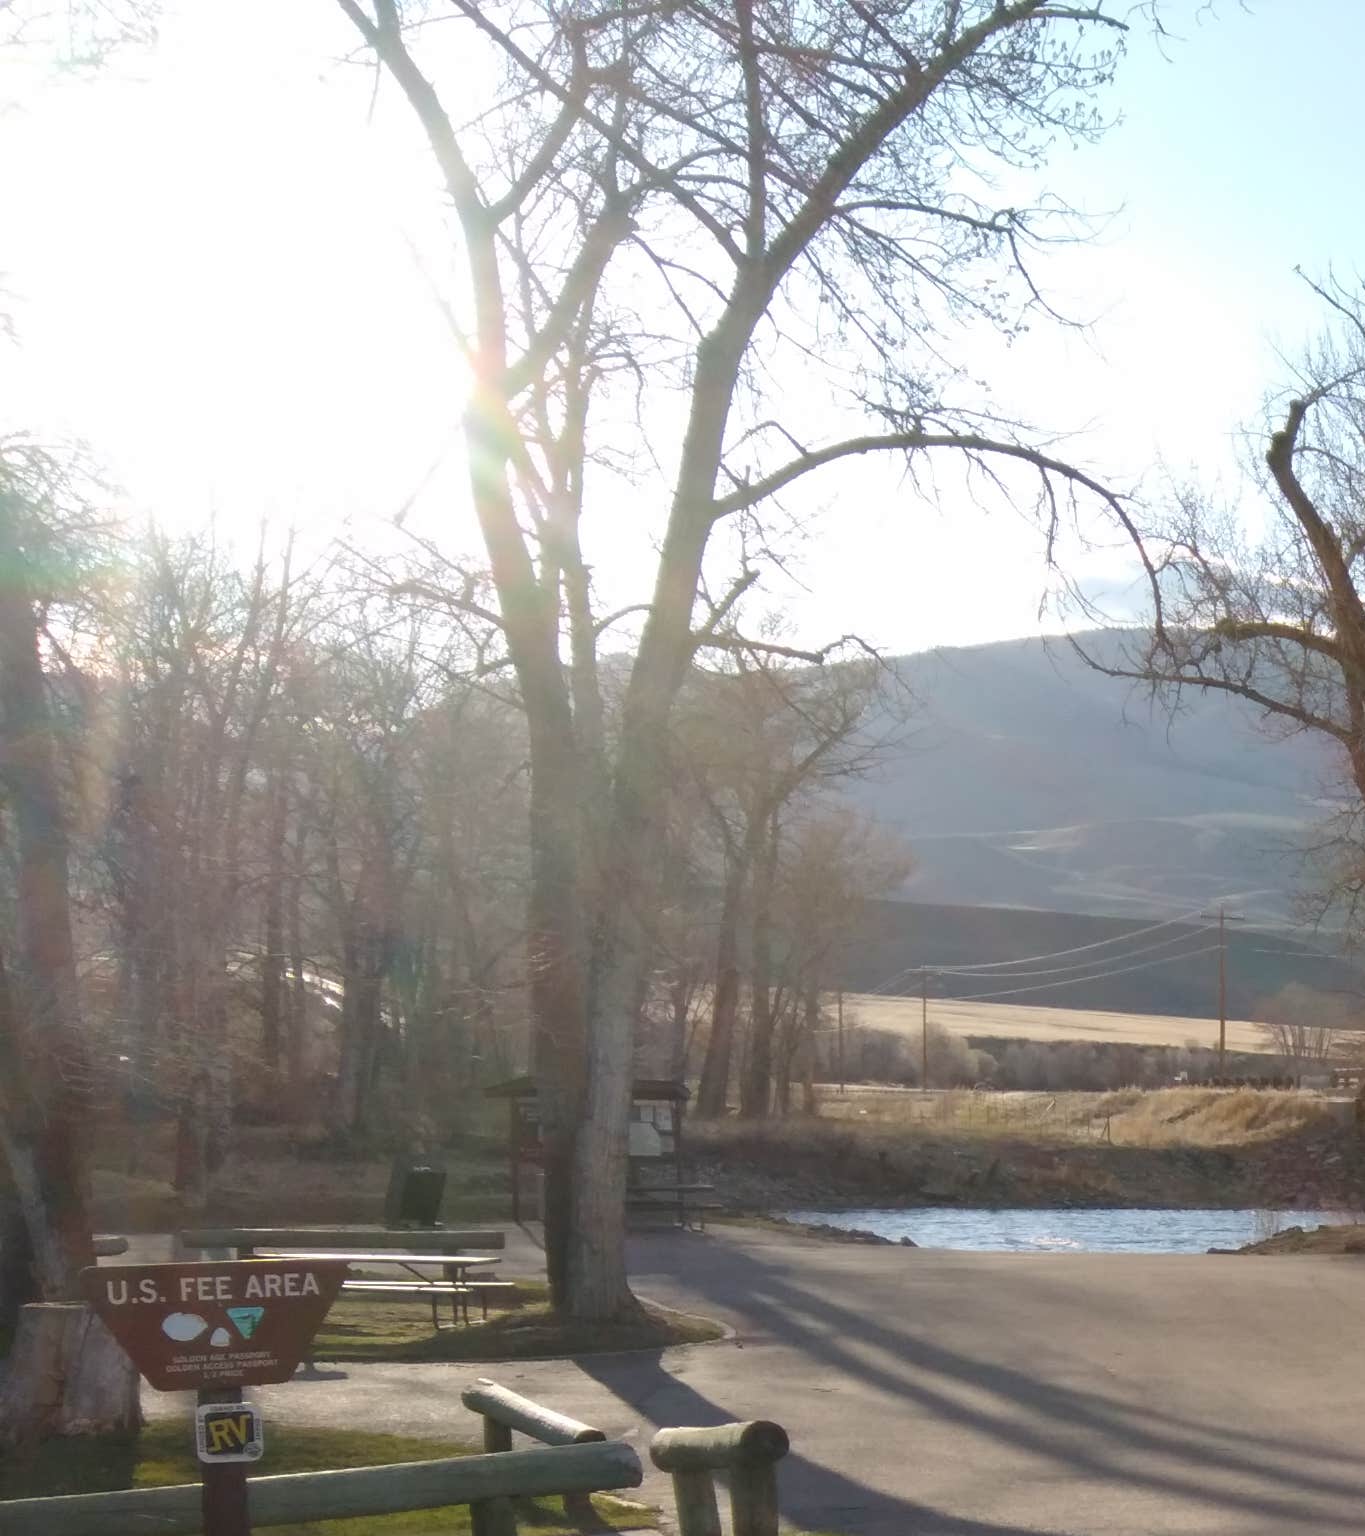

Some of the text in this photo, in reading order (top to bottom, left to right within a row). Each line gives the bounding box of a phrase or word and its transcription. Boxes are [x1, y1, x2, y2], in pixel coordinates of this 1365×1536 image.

[107, 1273, 320, 1304] U.S. FEE AREA
[207, 1414, 251, 1453] RV
